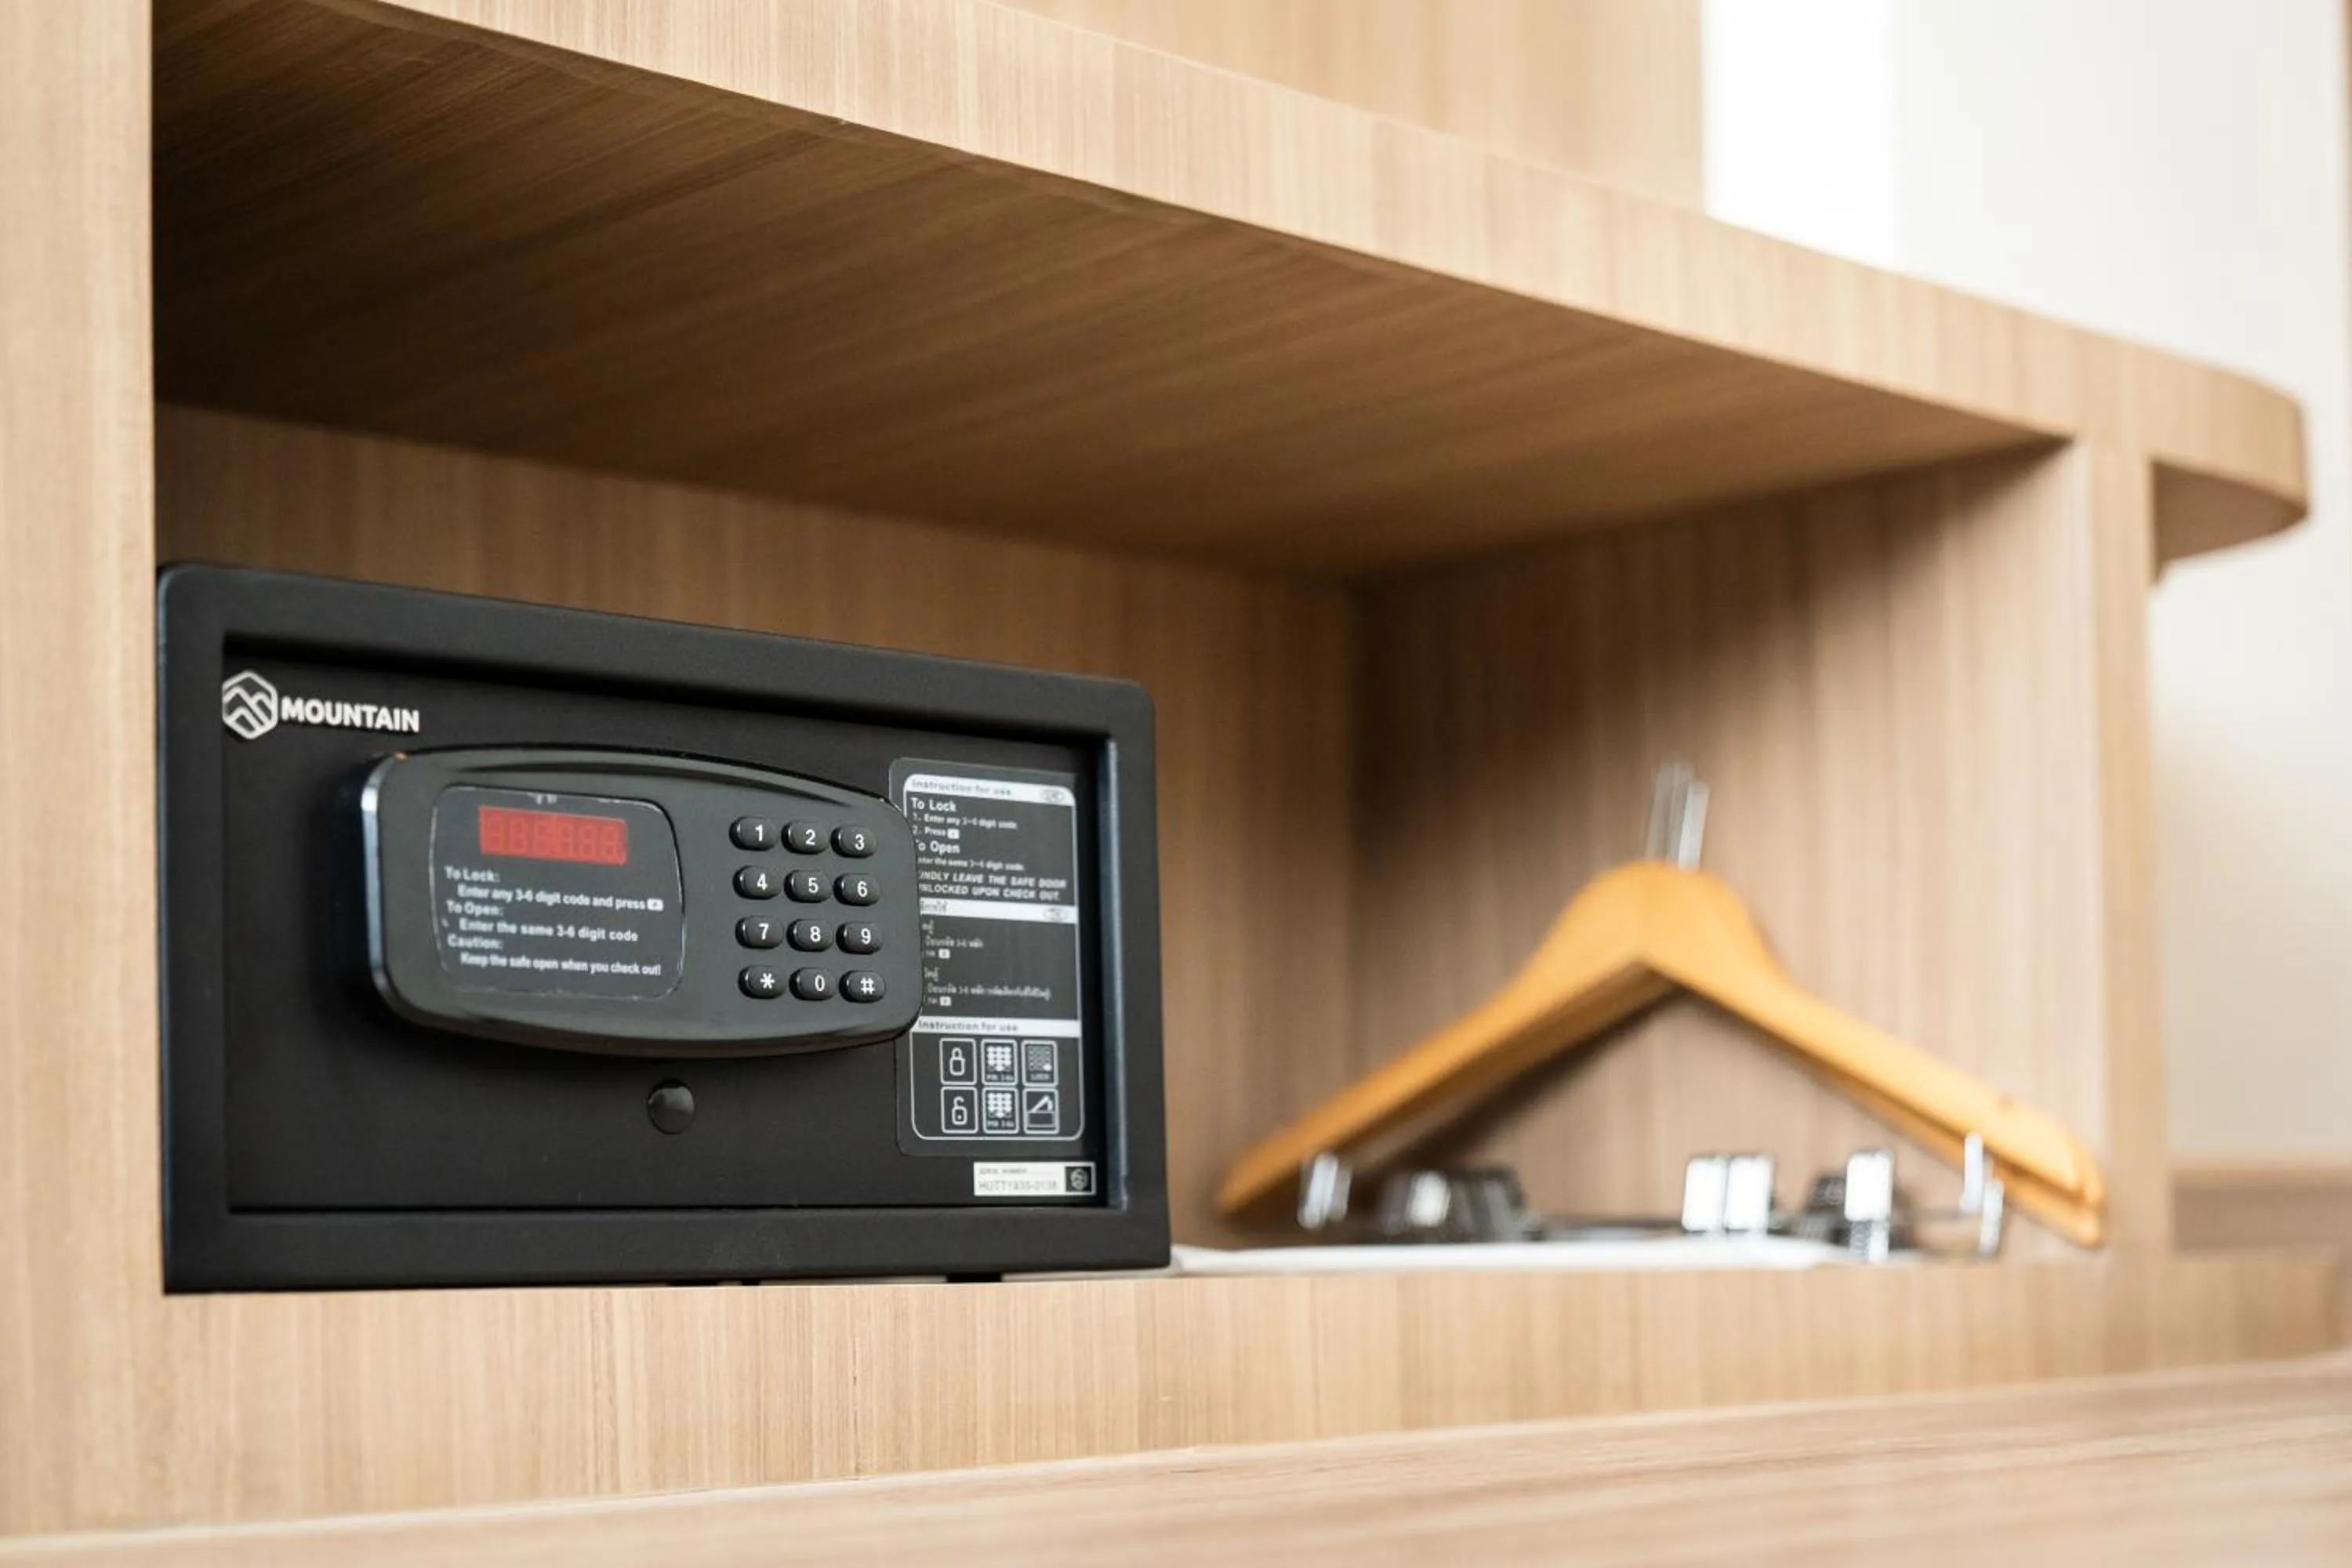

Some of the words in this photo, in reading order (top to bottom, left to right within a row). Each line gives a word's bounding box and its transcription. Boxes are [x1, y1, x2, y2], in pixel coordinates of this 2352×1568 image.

[281, 695, 420, 733] MOUNTAIN
[912, 779, 972, 793] Instruction
[975, 785, 990, 793] for
[911, 797, 925, 810] To
[928, 800, 958, 812] Lock
[755, 824, 764, 841] 1
[805, 829, 816, 845] 2
[924, 826, 946, 837] Press
[855, 833, 865, 851] 3
[930, 840, 960, 855] Open
[445, 866, 461, 880] To
[463, 869, 500, 883] Lock:
[757, 873, 768, 891] 4
[953, 873, 984, 884] LEAVE
[988, 874, 1007, 886] THE
[1011, 877, 1036, 887] SAFE
[808, 877, 819, 893] 5
[857, 881, 868, 898] 6
[458, 884, 490, 898] Enter
[492, 889, 513, 902] any
[515, 888, 534, 902] 3-6
[535, 891, 561, 906] digit
[563, 895, 591, 906] code
[592, 895, 613, 908] and
[615, 898, 645, 911] press
[971, 887, 1000, 898] UPON
[1003, 889, 1036, 901] CHECK
[446, 901, 463, 914] To
[465, 902, 503, 917] Open:
[459, 918, 494, 931] Enter
[496, 920, 517, 935] the
[521, 924, 554, 936] same
[578, 926, 606, 942] digit
[609, 930, 638, 942] code
[759, 923, 769, 940] 7
[810, 926, 822, 942] 8
[861, 928, 871, 945] 9
[448, 934, 503, 949] Caution:
[460, 951, 489, 967] Keep
[489, 953, 508, 966] the
[509, 955, 531, 968] safe
[533, 958, 559, 971] open
[561, 959, 589, 973] when
[590, 964, 609, 975] you
[610, 961, 641, 975] check
[815, 975, 826, 992] 0
[918, 1020, 979, 1031] Instruction
[982, 1022, 997, 1032] for
[999, 1023, 1018, 1032] use
